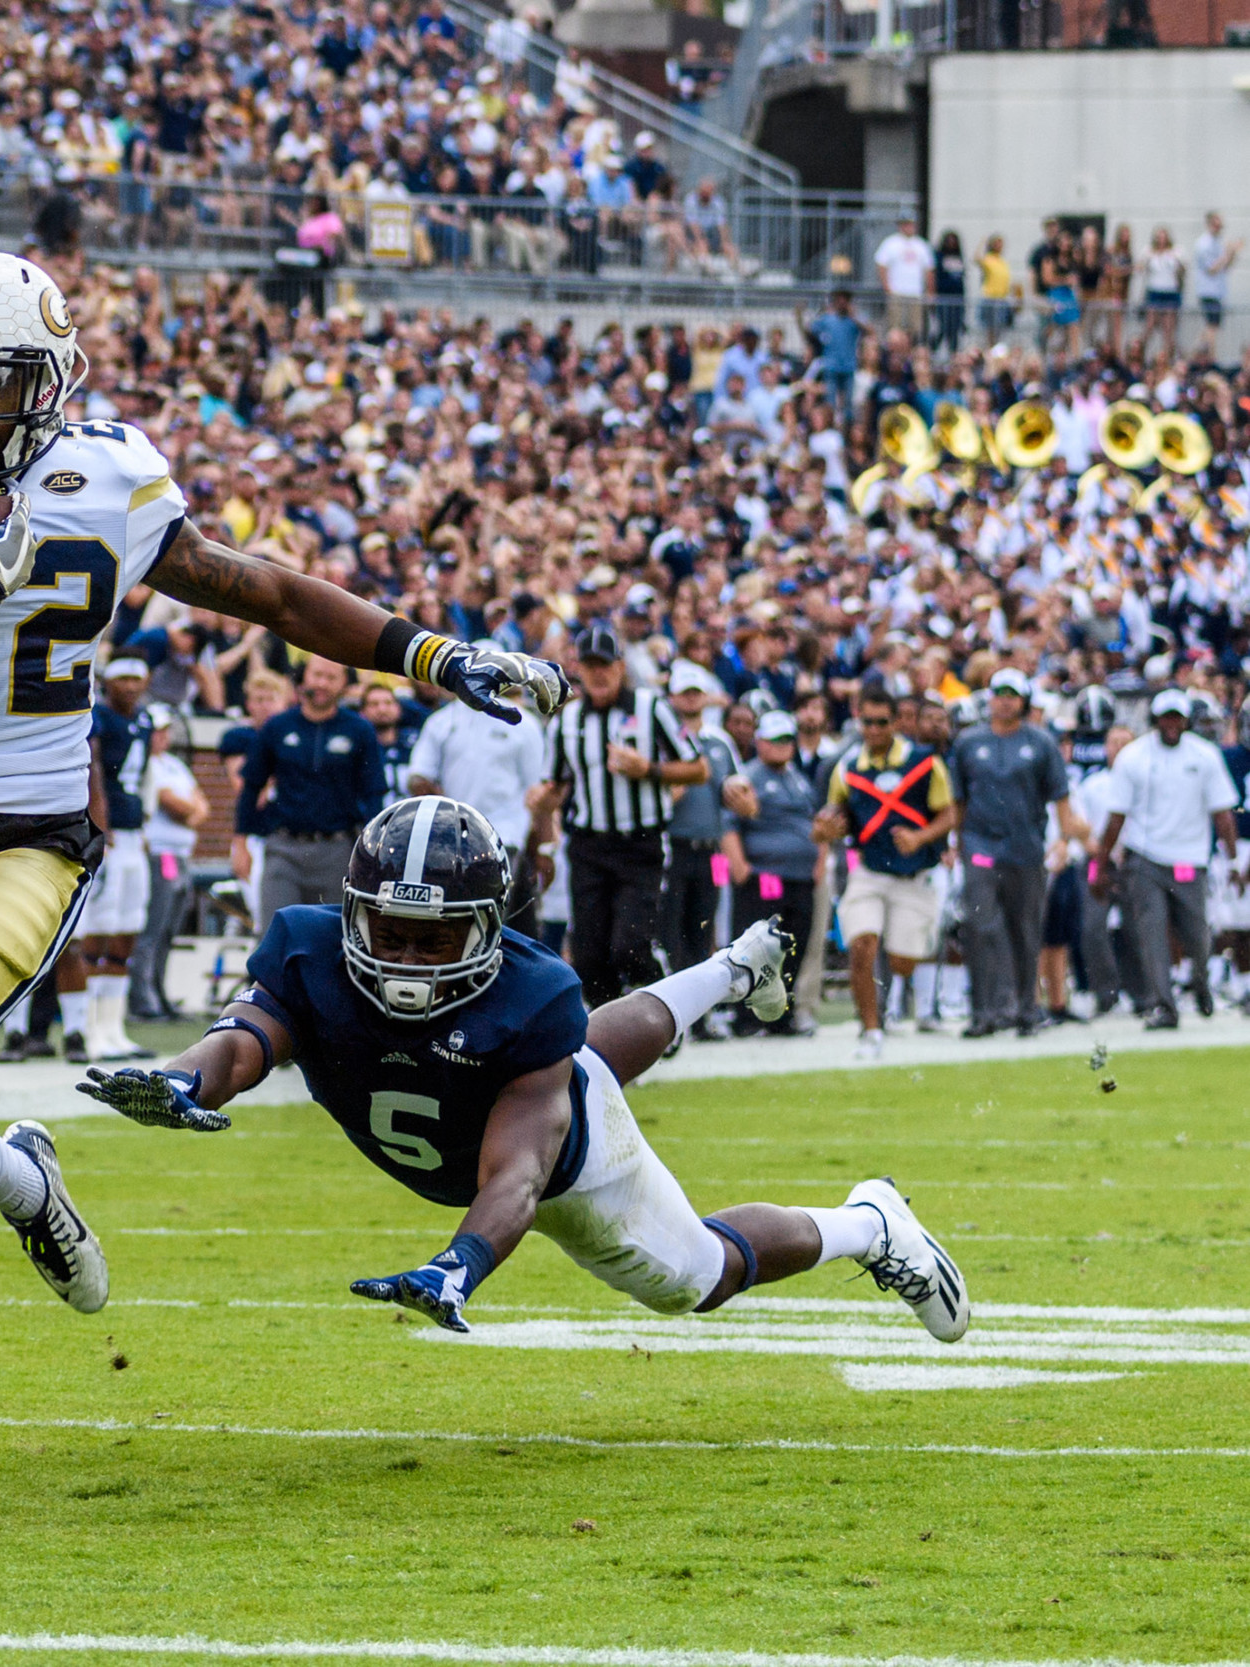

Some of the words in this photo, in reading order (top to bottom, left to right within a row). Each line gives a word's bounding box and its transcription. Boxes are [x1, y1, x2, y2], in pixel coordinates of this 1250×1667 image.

[48, 474, 80, 487] ACC
[394, 885, 430, 901] GATA
[369, 1090, 443, 1172] 5
